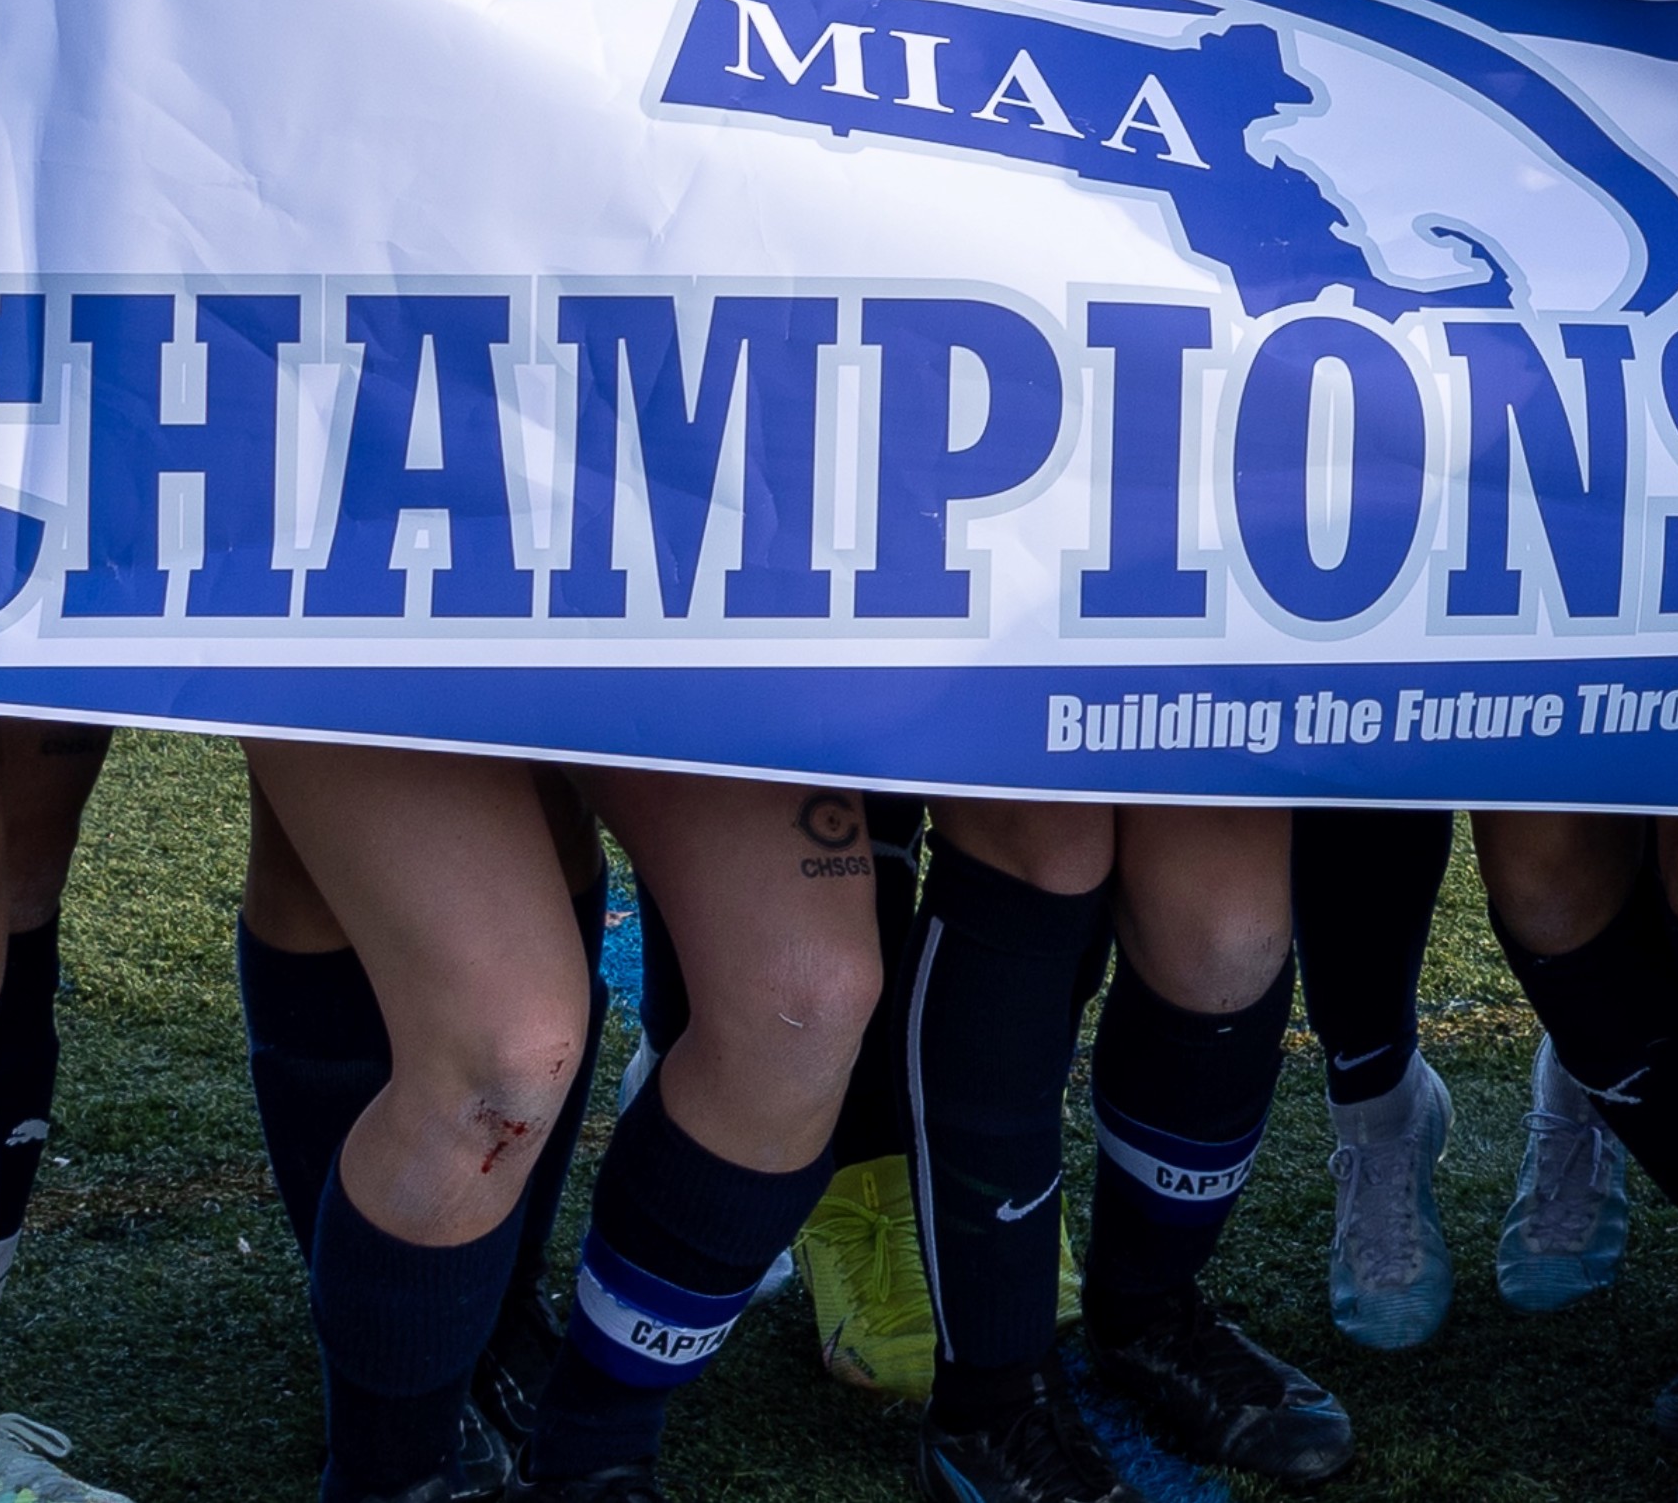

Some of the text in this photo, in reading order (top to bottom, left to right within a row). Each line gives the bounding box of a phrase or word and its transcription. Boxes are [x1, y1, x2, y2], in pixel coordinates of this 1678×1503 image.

[1047, 692, 1281, 756] Building
[1294, 687, 1382, 744] the
[1394, 684, 1563, 742] Future
[801, 855, 871, 878] CHSGS
